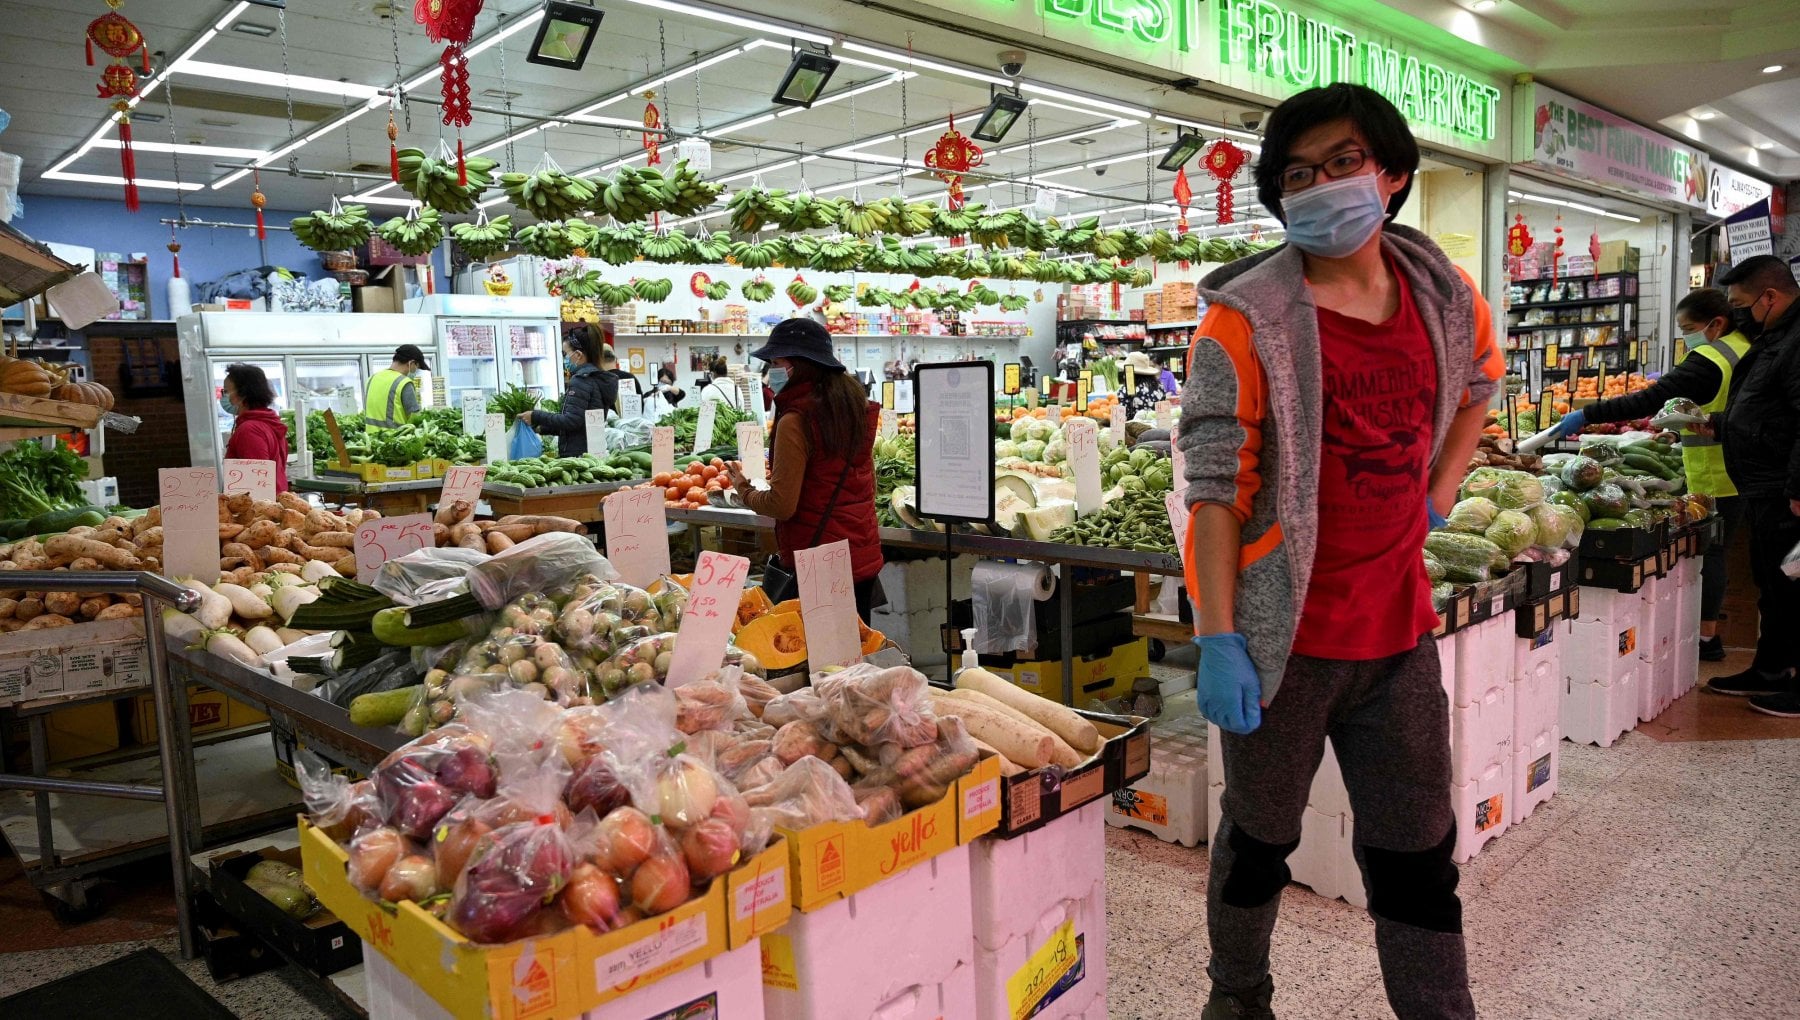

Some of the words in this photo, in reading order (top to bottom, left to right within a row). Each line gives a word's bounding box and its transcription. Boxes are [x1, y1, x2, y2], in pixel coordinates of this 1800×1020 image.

[1220, 0, 1356, 88] FRUIT
[1362, 42, 1500, 140] MARKET
[1549, 101, 1564, 124] THE
[1567, 107, 1603, 152] BEST
[1606, 125, 1644, 167] FRUIT
[1645, 142, 1690, 184] MARKET
[1728, 222, 1748, 232] EXPRESS
[1731, 233, 1747, 242] PHONE
[1748, 231, 1768, 240] REPAIRS
[1323, 359, 1435, 398] AMMERHEA
[1336, 397, 1418, 429] WHISKY
[190, 471, 214, 487] 99
[361, 529, 387, 570] 3
[698, 555, 715, 586] 3
[717, 560, 741, 589] 4
[700, 597, 717, 606] 50
[968, 784, 991, 798] PRODUCE
[976, 795, 983, 803] OF
[1114, 789, 1141, 802] CORN
[967, 799, 992, 815] AUSTRALIA
[1016, 814, 1032, 825] CLASS
[744, 875, 776, 894] PRODUCE
[743, 893, 779, 913] AUSTRALIA
